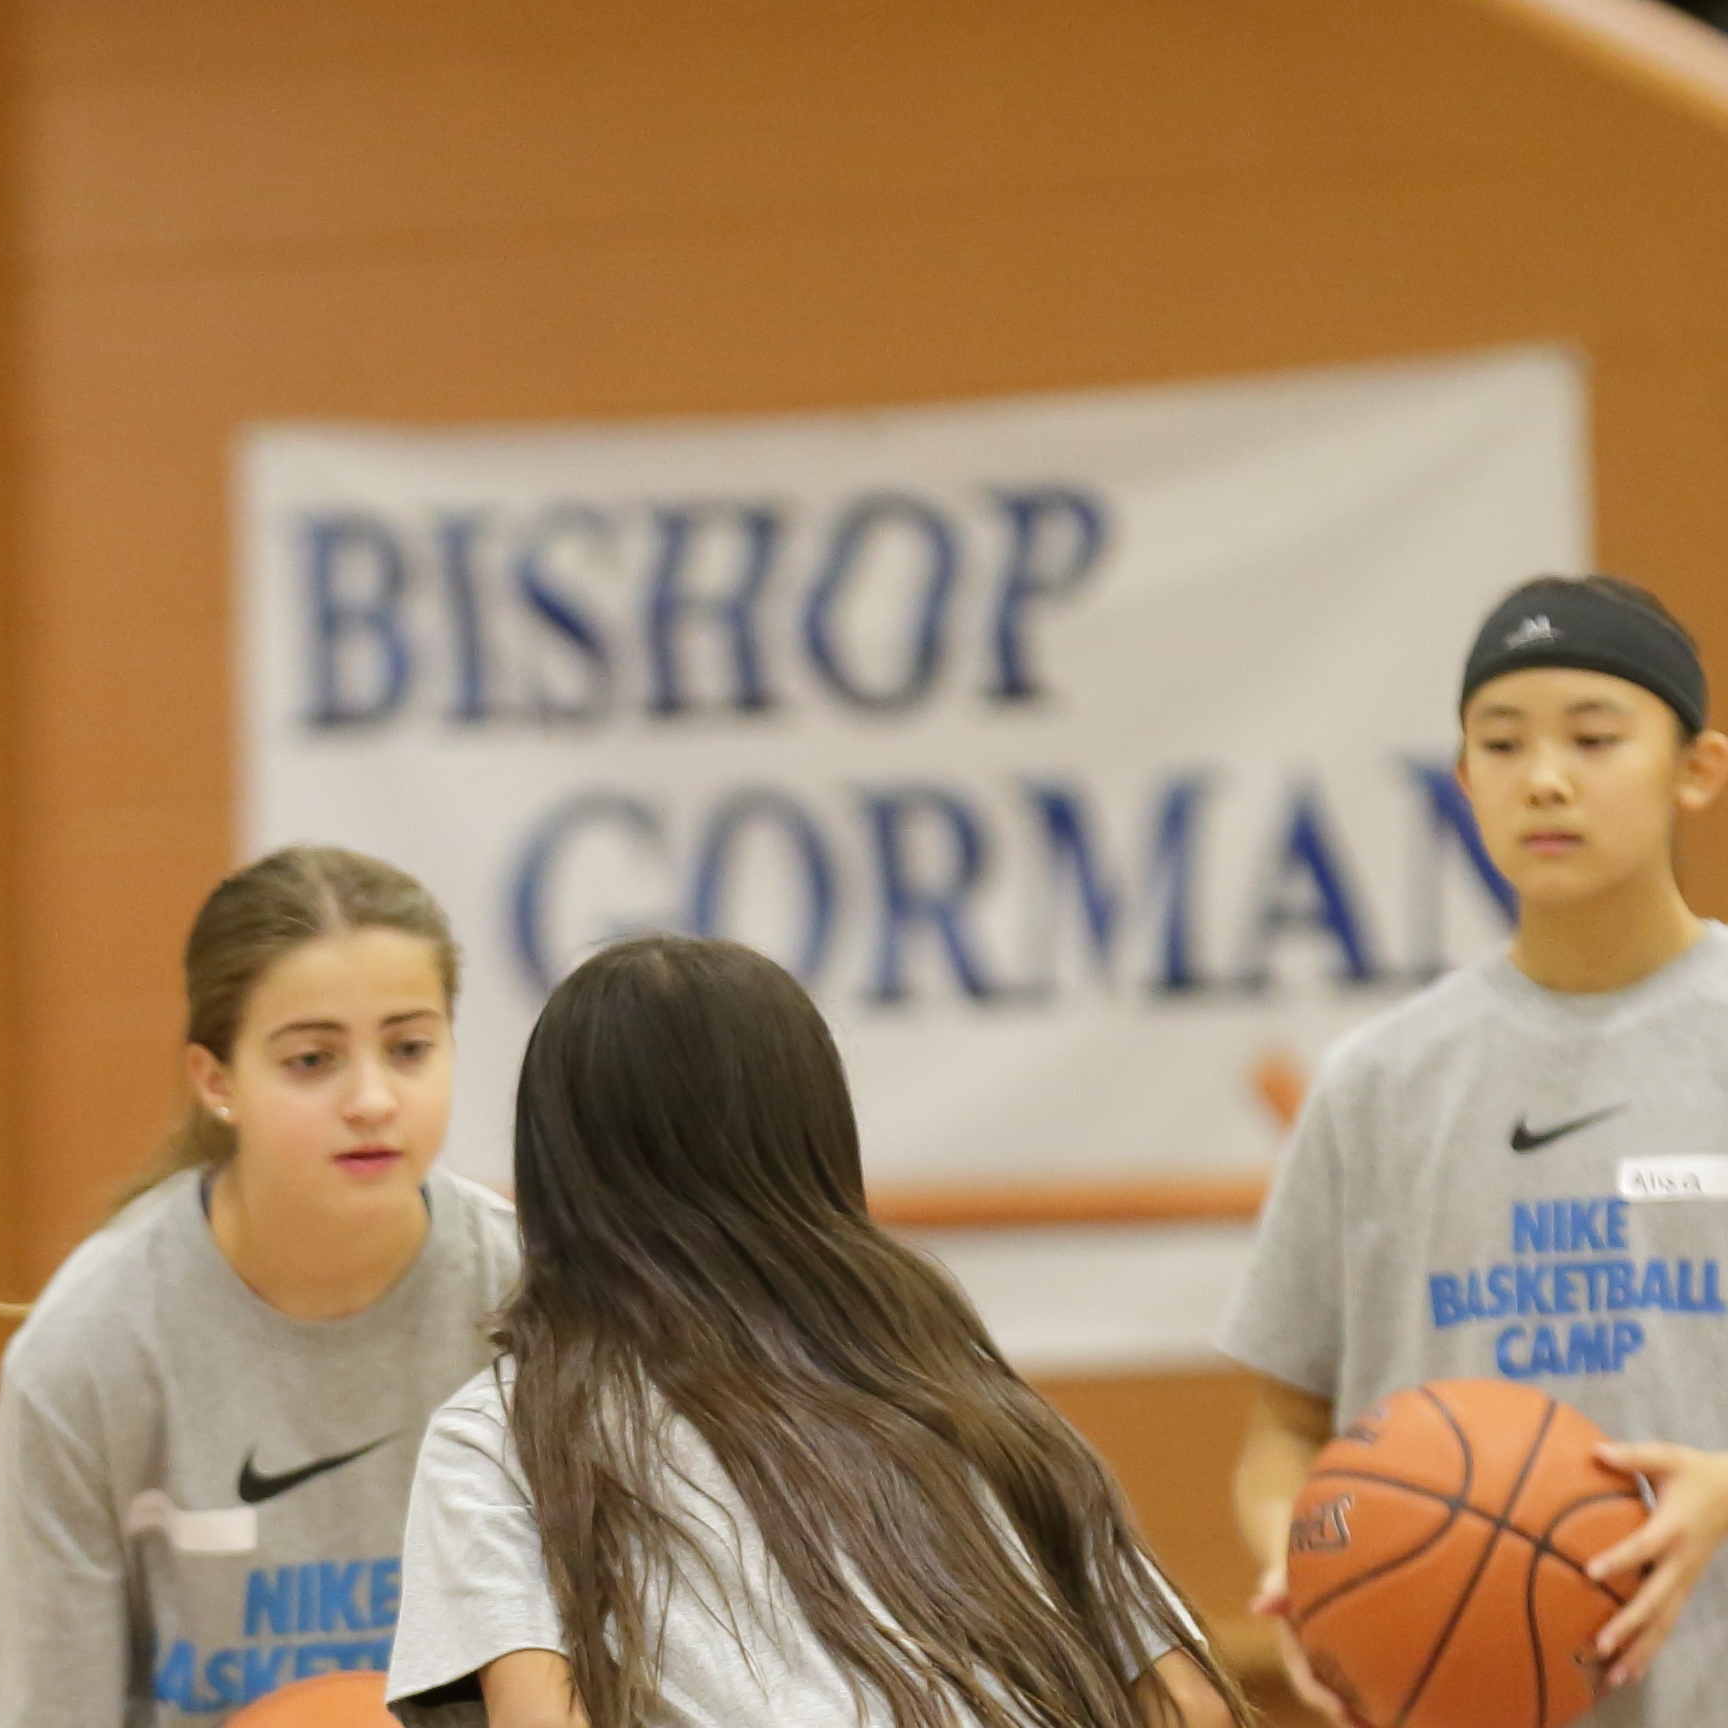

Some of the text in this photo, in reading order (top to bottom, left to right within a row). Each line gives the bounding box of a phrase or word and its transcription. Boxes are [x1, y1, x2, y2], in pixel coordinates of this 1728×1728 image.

[289, 476, 1114, 735] BISHOP
[1511, 1197, 1630, 1254] NIKE
[1427, 1257, 1728, 1328] BASKETBALL
[1493, 1319, 1646, 1378] CAMP
[243, 1556, 403, 1637] NIKE
